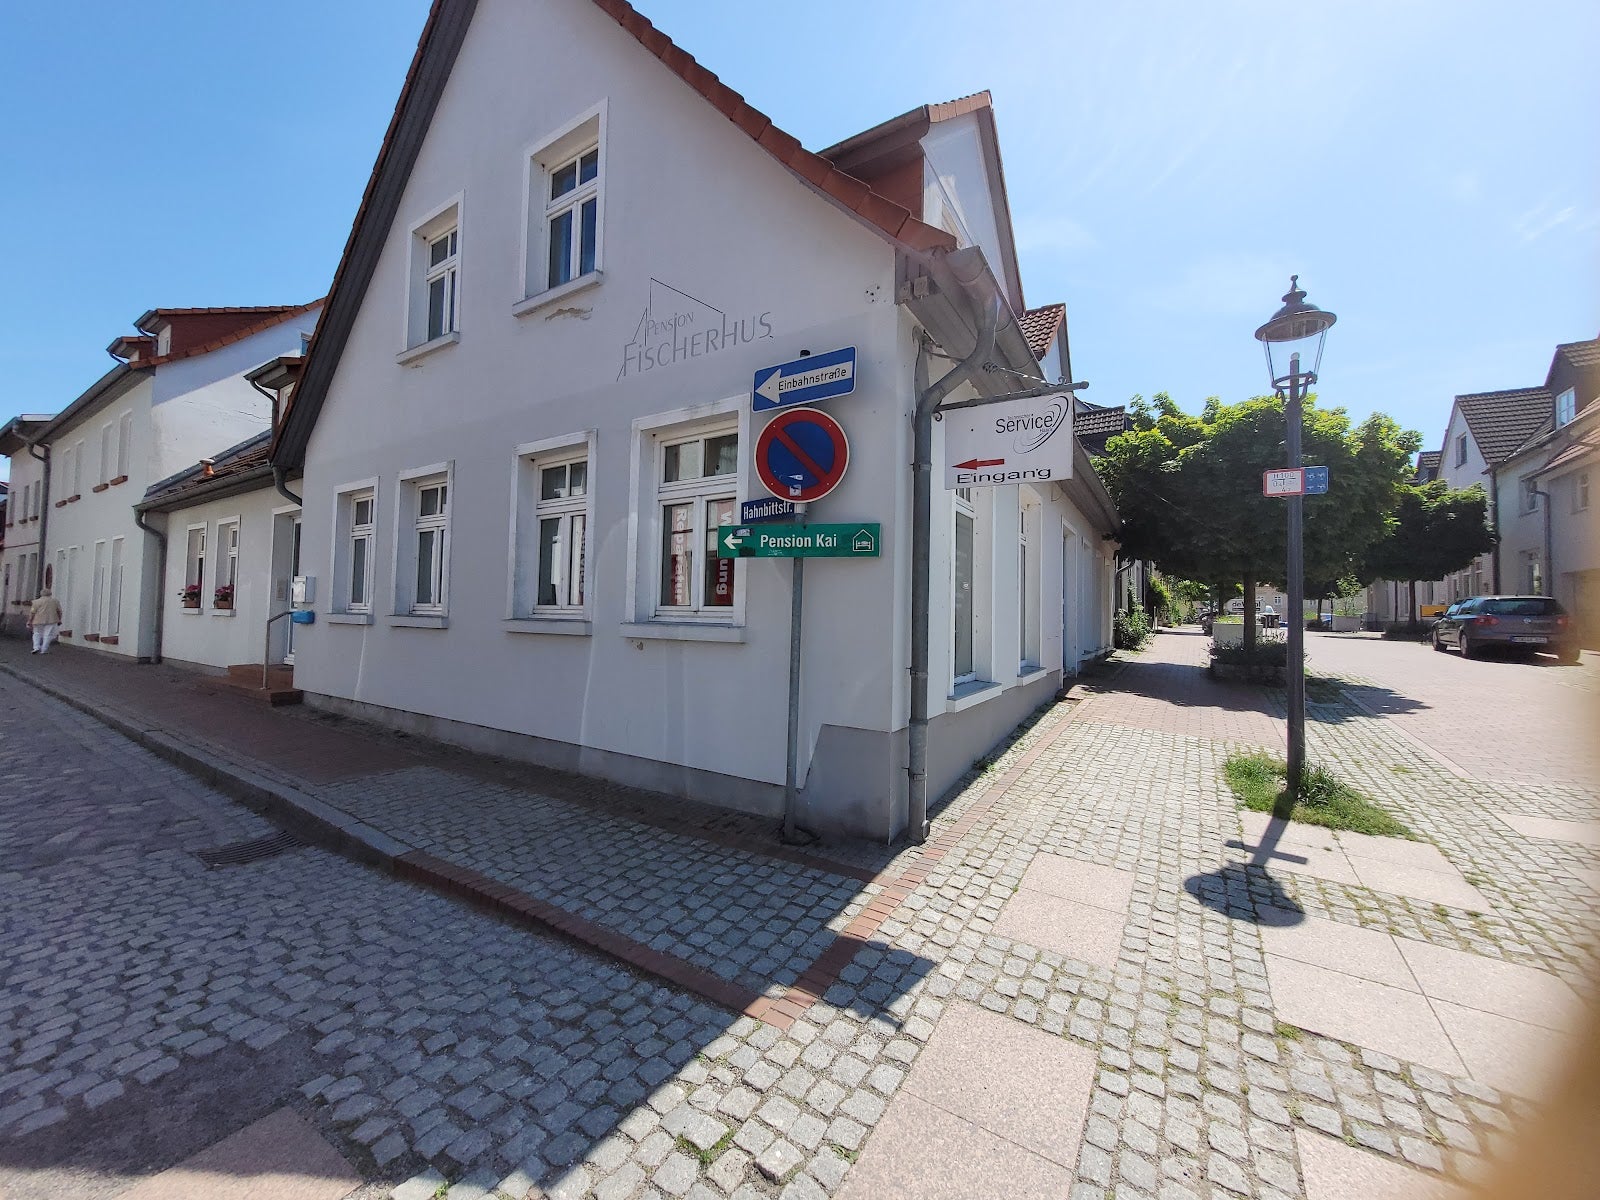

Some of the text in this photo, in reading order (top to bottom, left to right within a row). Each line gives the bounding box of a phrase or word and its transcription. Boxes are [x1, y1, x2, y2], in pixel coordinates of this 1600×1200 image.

[778, 367, 847, 391] Einbahnstraße
[995, 413, 1053, 434] Service
[956, 468, 1051, 484] Eingang
[743, 502, 793, 520] Hahnbittstr.
[760, 534, 837, 548] Pension Kai
[674, 508, 688, 604] Reparatur
